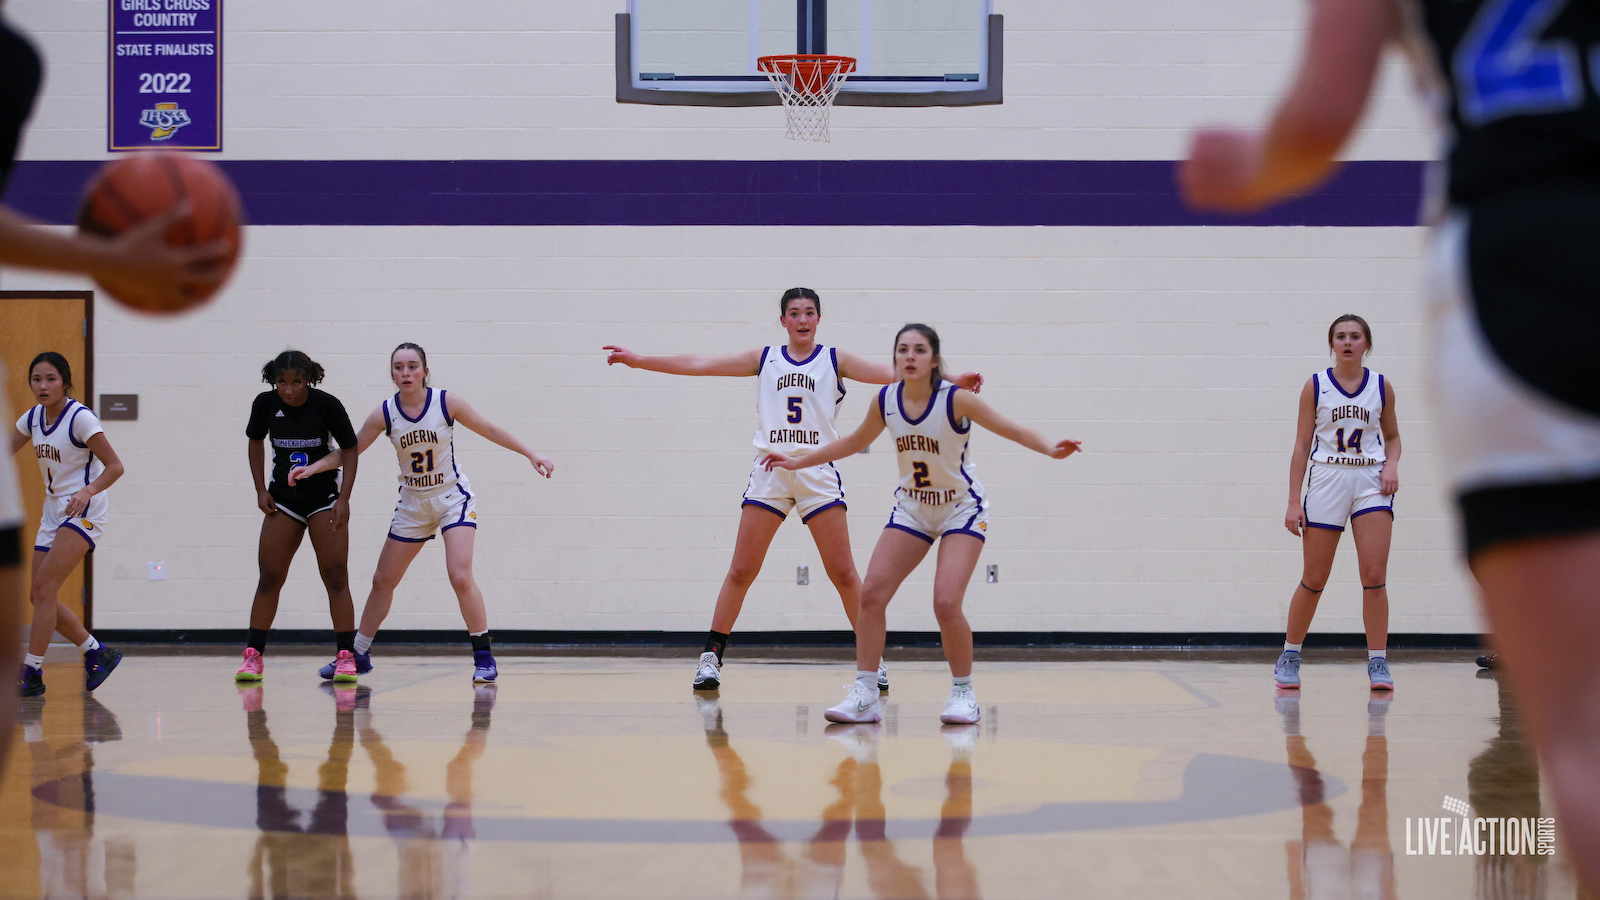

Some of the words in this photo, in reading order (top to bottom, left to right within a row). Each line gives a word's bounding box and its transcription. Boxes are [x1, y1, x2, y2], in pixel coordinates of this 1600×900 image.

[121, 0, 161, 11] GIRLS
[164, 0, 211, 11] CROSS
[134, 13, 197, 27] COUNTRY
[117, 44, 152, 56] STATE
[155, 44, 214, 56] FINALISTS
[139, 72, 191, 94] 2022
[141, 109, 189, 129] IHSAA
[777, 373, 815, 392] GUERIN
[787, 396, 803, 424] 5
[1331, 405, 1370, 424] GUERIN
[400, 429, 439, 449] GUERIN
[769, 429, 819, 445] CATHOLIC
[896, 434, 940, 455] GUERIN
[1335, 428, 1365, 454] 14
[410, 448, 435, 474] 21
[912, 461, 932, 488] 2
